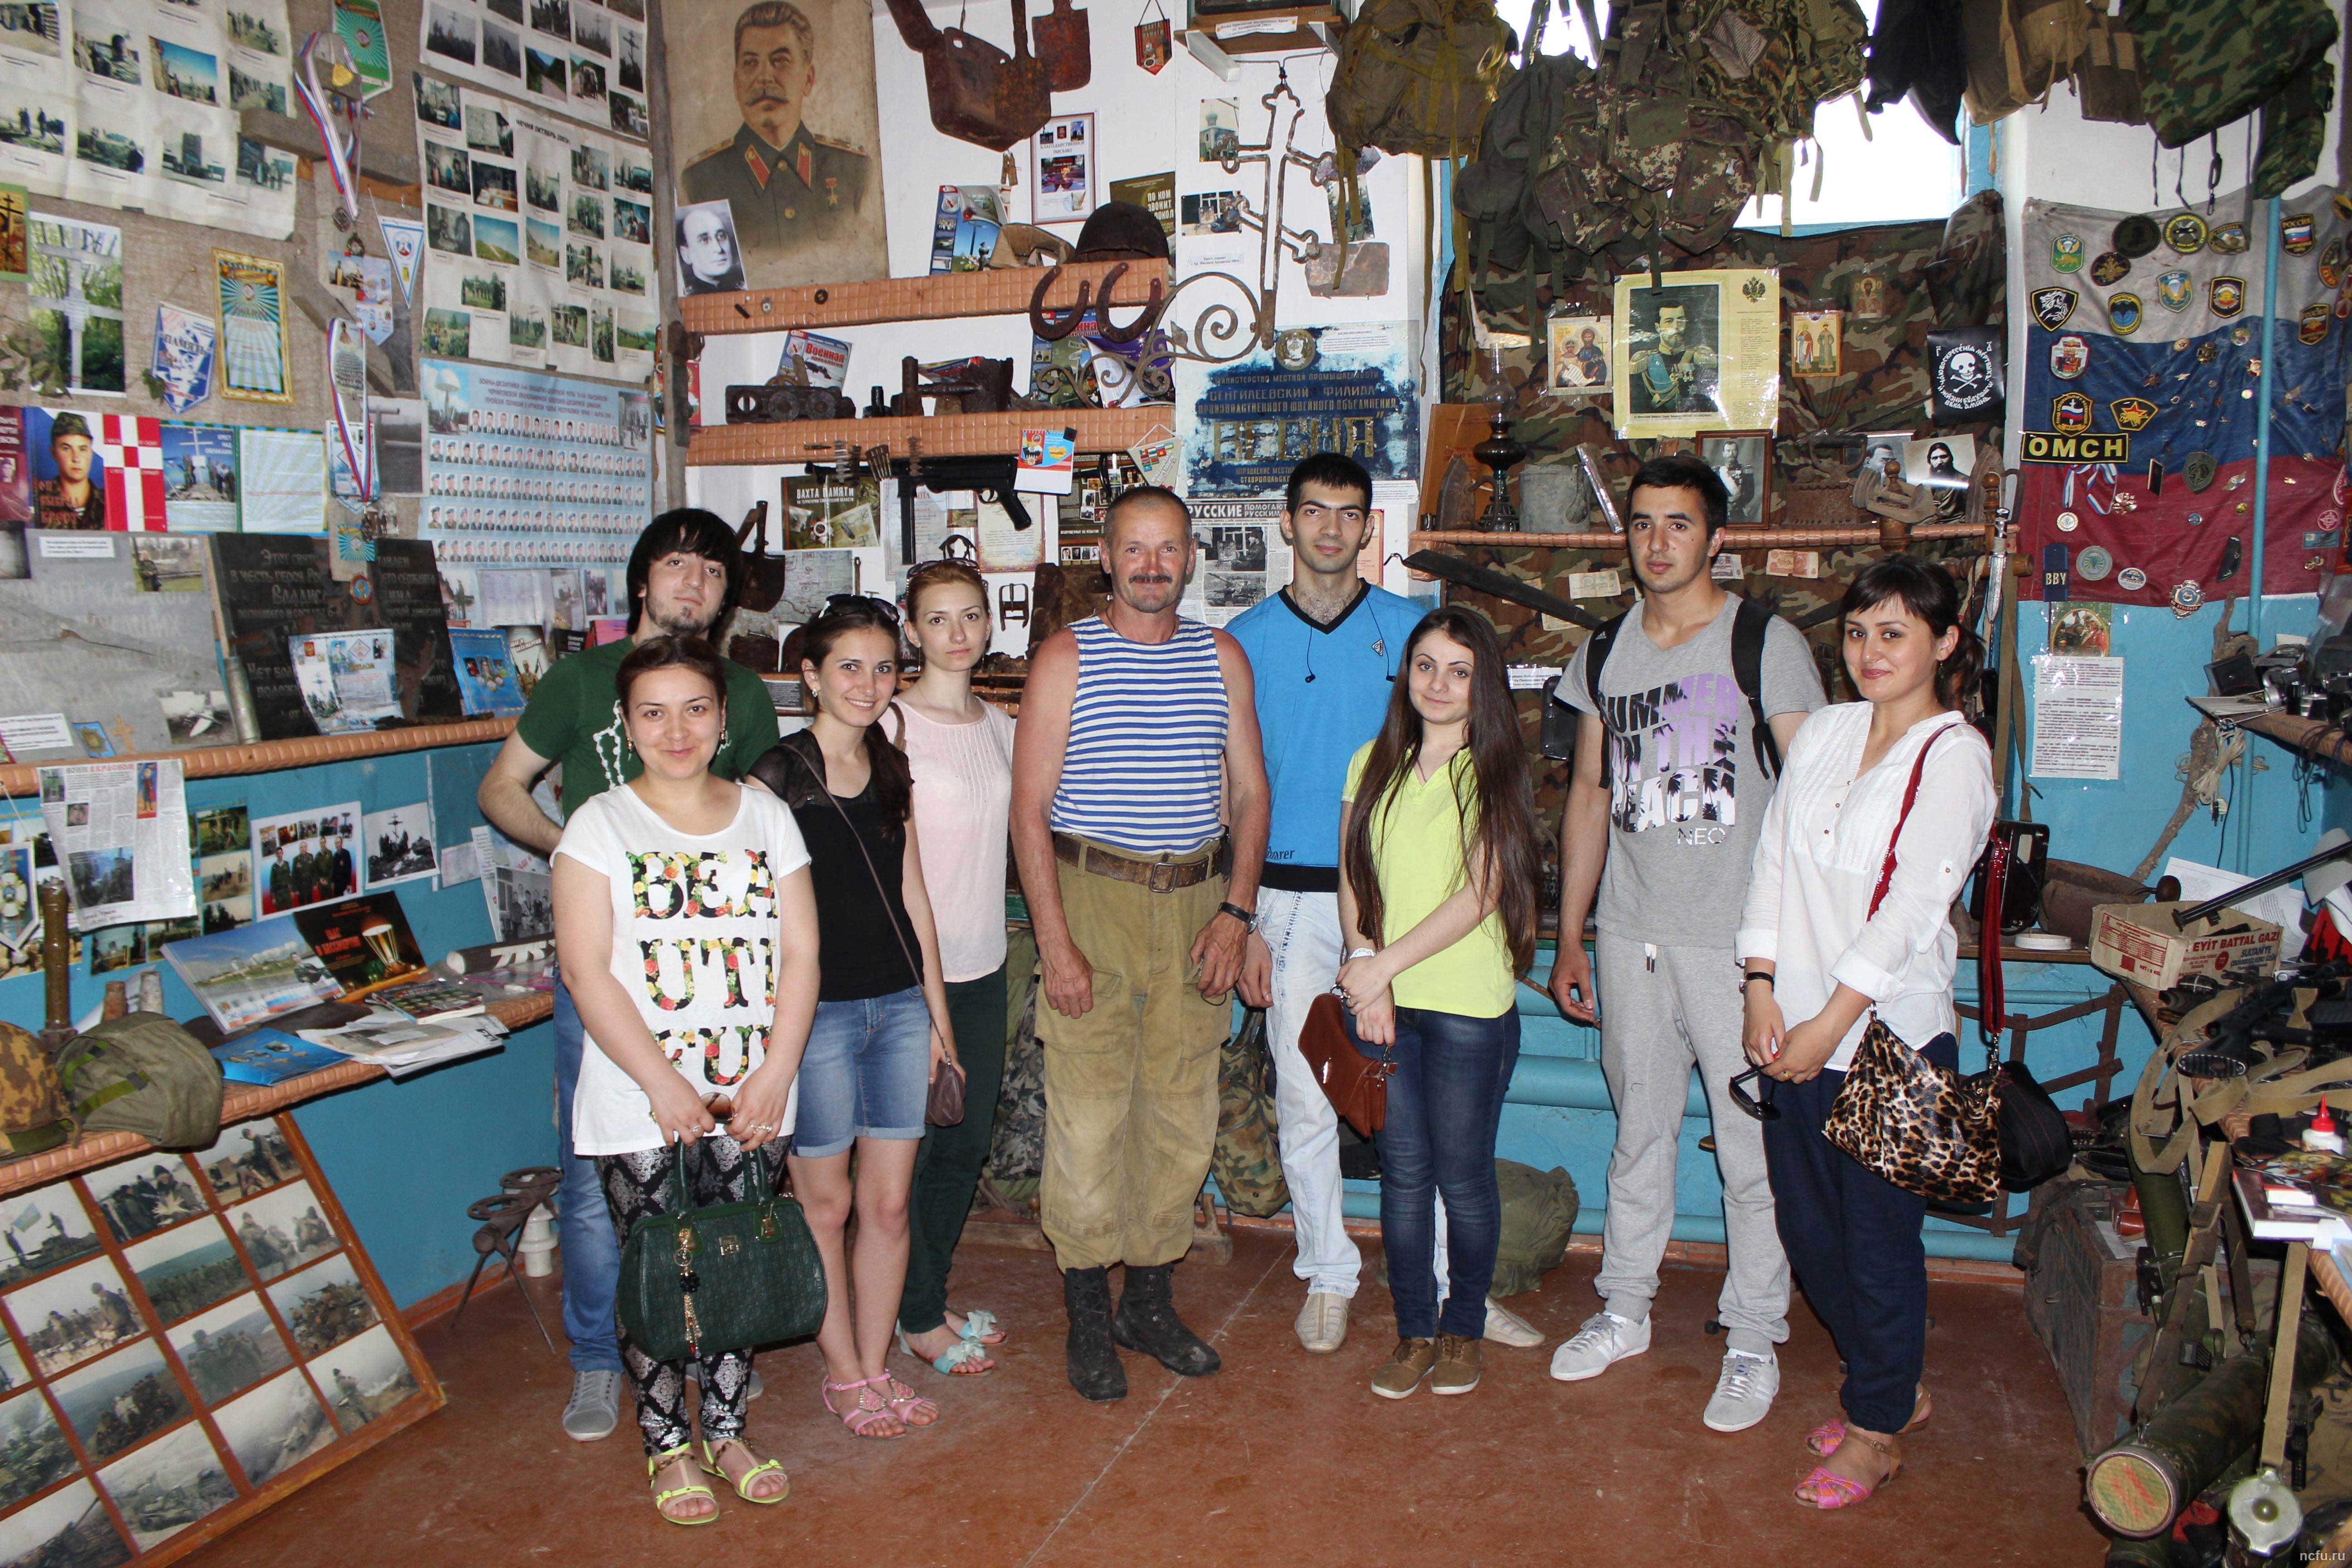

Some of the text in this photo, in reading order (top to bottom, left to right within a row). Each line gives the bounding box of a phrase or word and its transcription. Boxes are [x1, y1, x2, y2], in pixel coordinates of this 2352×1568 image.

[1040, 141, 1085, 149] БЛАГОДАРСТВЕННОЕ
[1147, 189, 1171, 202] ПО КОМ
[1147, 200, 1171, 211] ЗВОНИТ
[2282, 218, 2311, 228] РОССИЯ
[164, 333, 206, 356] ПАМЯТЬ
[806, 343, 844, 363] Военная
[1215, 376, 1269, 385] МИНИСТЕРСТВО
[1309, 371, 1378, 381] ПРОМЫШЛЕННОСТИ
[1210, 386, 1376, 402] СЕНГИЛЕЕВСКИЙ ФИЛИАЛ
[1197, 402, 1288, 415] ПРОИЗВОДСТВЕННОГО
[1291, 400, 1333, 412] ШВЕЙНОГО
[2028, 437, 2123, 458] ОМСН
[1235, 466, 1295, 475] УПРАВЛЕНИЕ МЕСТНО
[797, 486, 854, 499] ВАХТА ПАМЯТИ
[1187, 504, 1242, 518] РУССКИЕ
[1597, 673, 1738, 733] SUMMER
[1653, 715, 1736, 774] THE
[1678, 828, 1725, 845] NEO
[626, 849, 778, 919] BEA
[2187, 937, 2217, 952] EYİT
[2220, 934, 2255, 948] BATTAL
